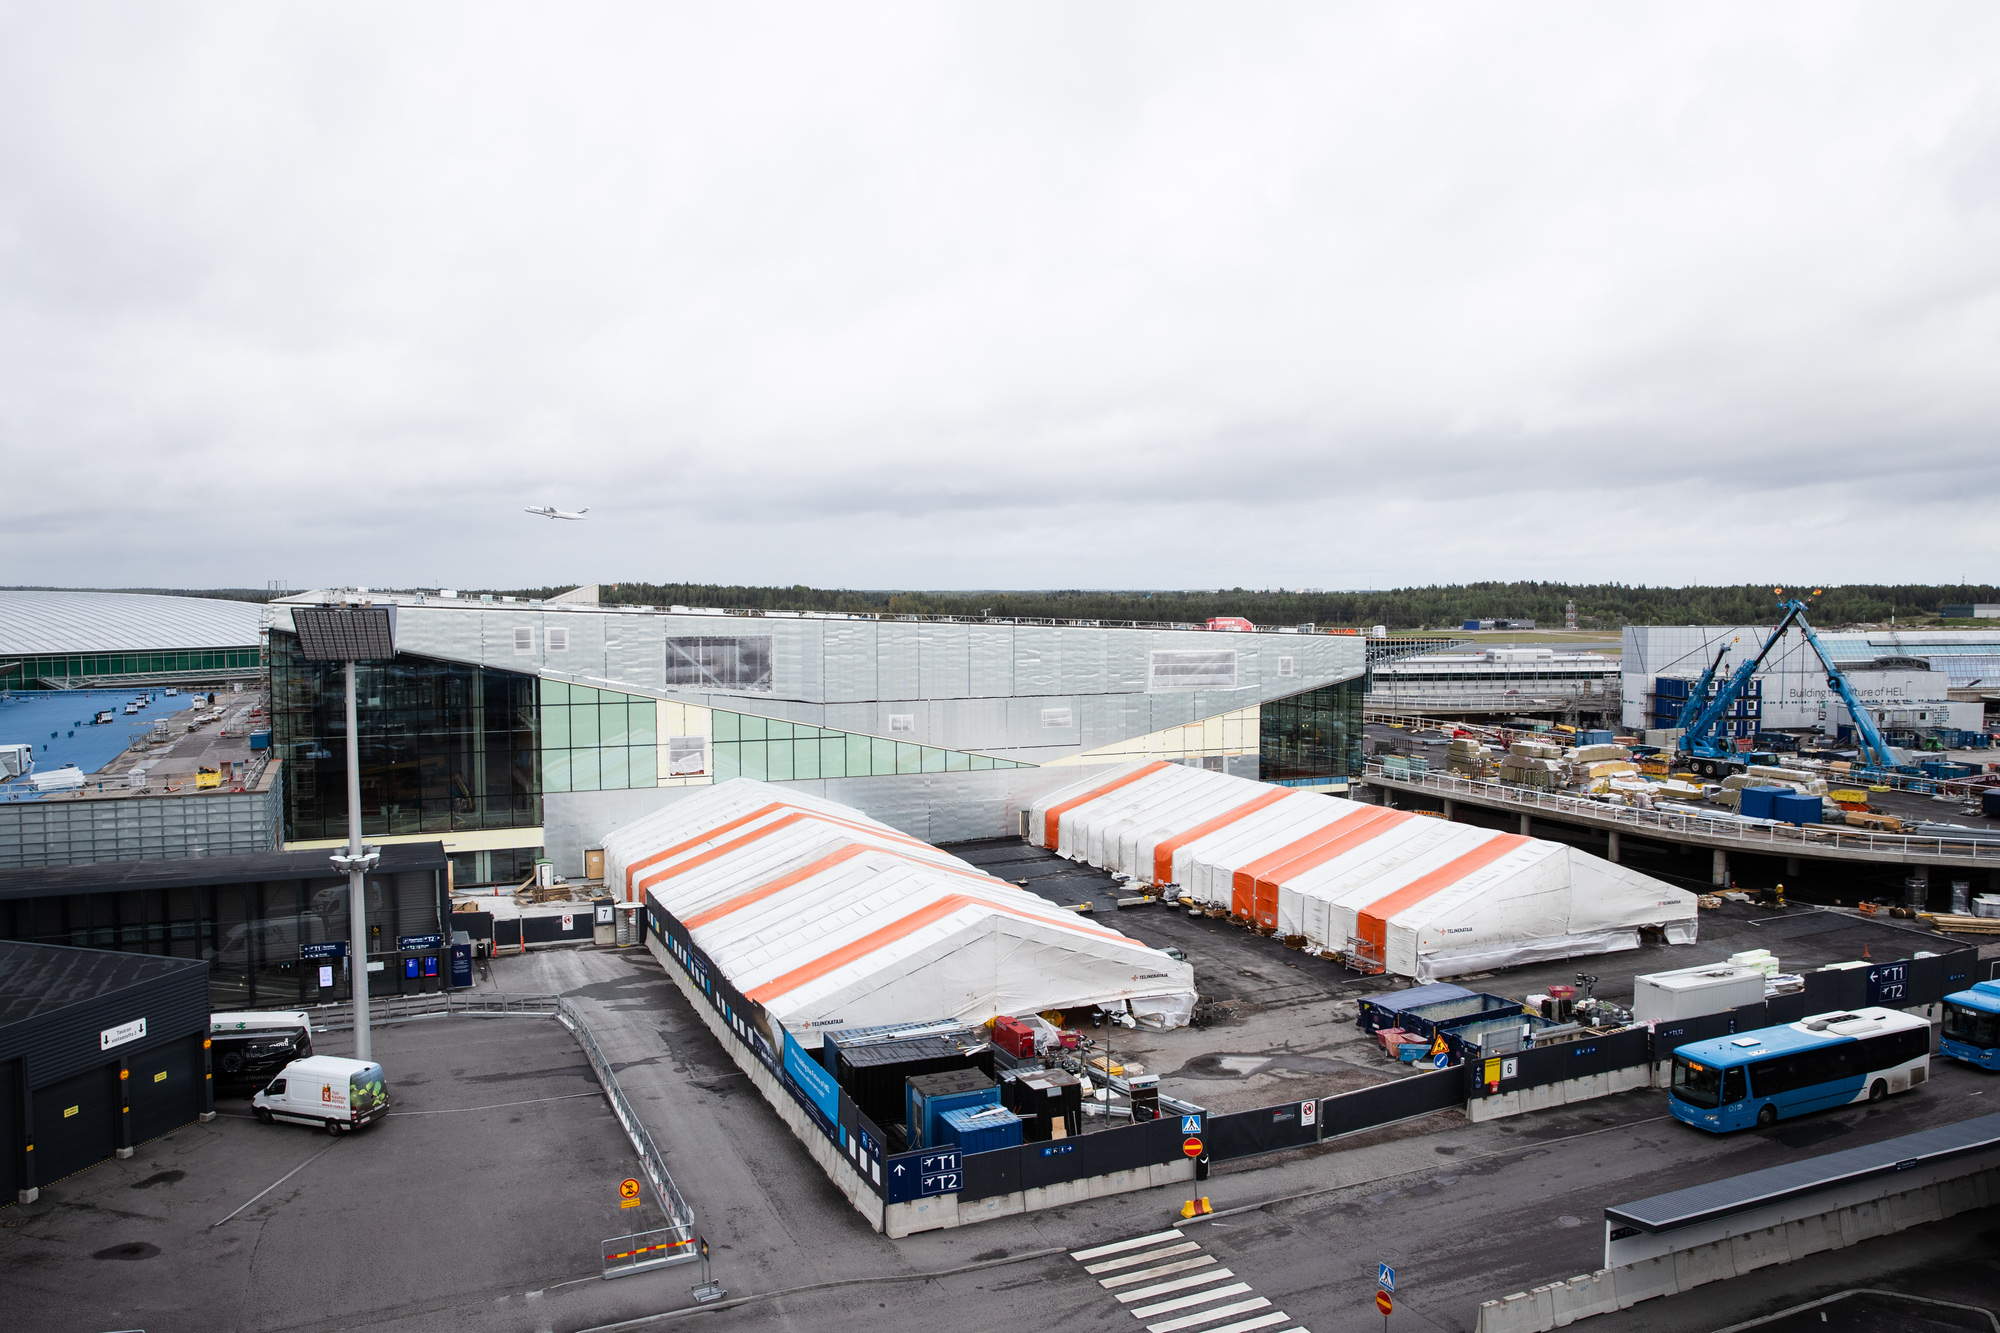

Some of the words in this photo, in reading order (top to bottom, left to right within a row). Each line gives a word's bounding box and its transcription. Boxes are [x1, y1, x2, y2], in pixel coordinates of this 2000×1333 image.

[1790, 688, 1826, 699] Building
[1875, 687, 1885, 697] of
[1886, 687, 1905, 697] HEL
[602, 909, 608, 919] 7
[1139, 972, 1169, 980] TELINEKATAJA
[1891, 966, 1904, 981] T1
[1890, 984, 1903, 998] T2
[811, 1018, 844, 1027] TELINEKATAJA
[1507, 1063, 1513, 1074] 6
[937, 1154, 955, 1170] T1
[936, 1173, 958, 1190] T2
